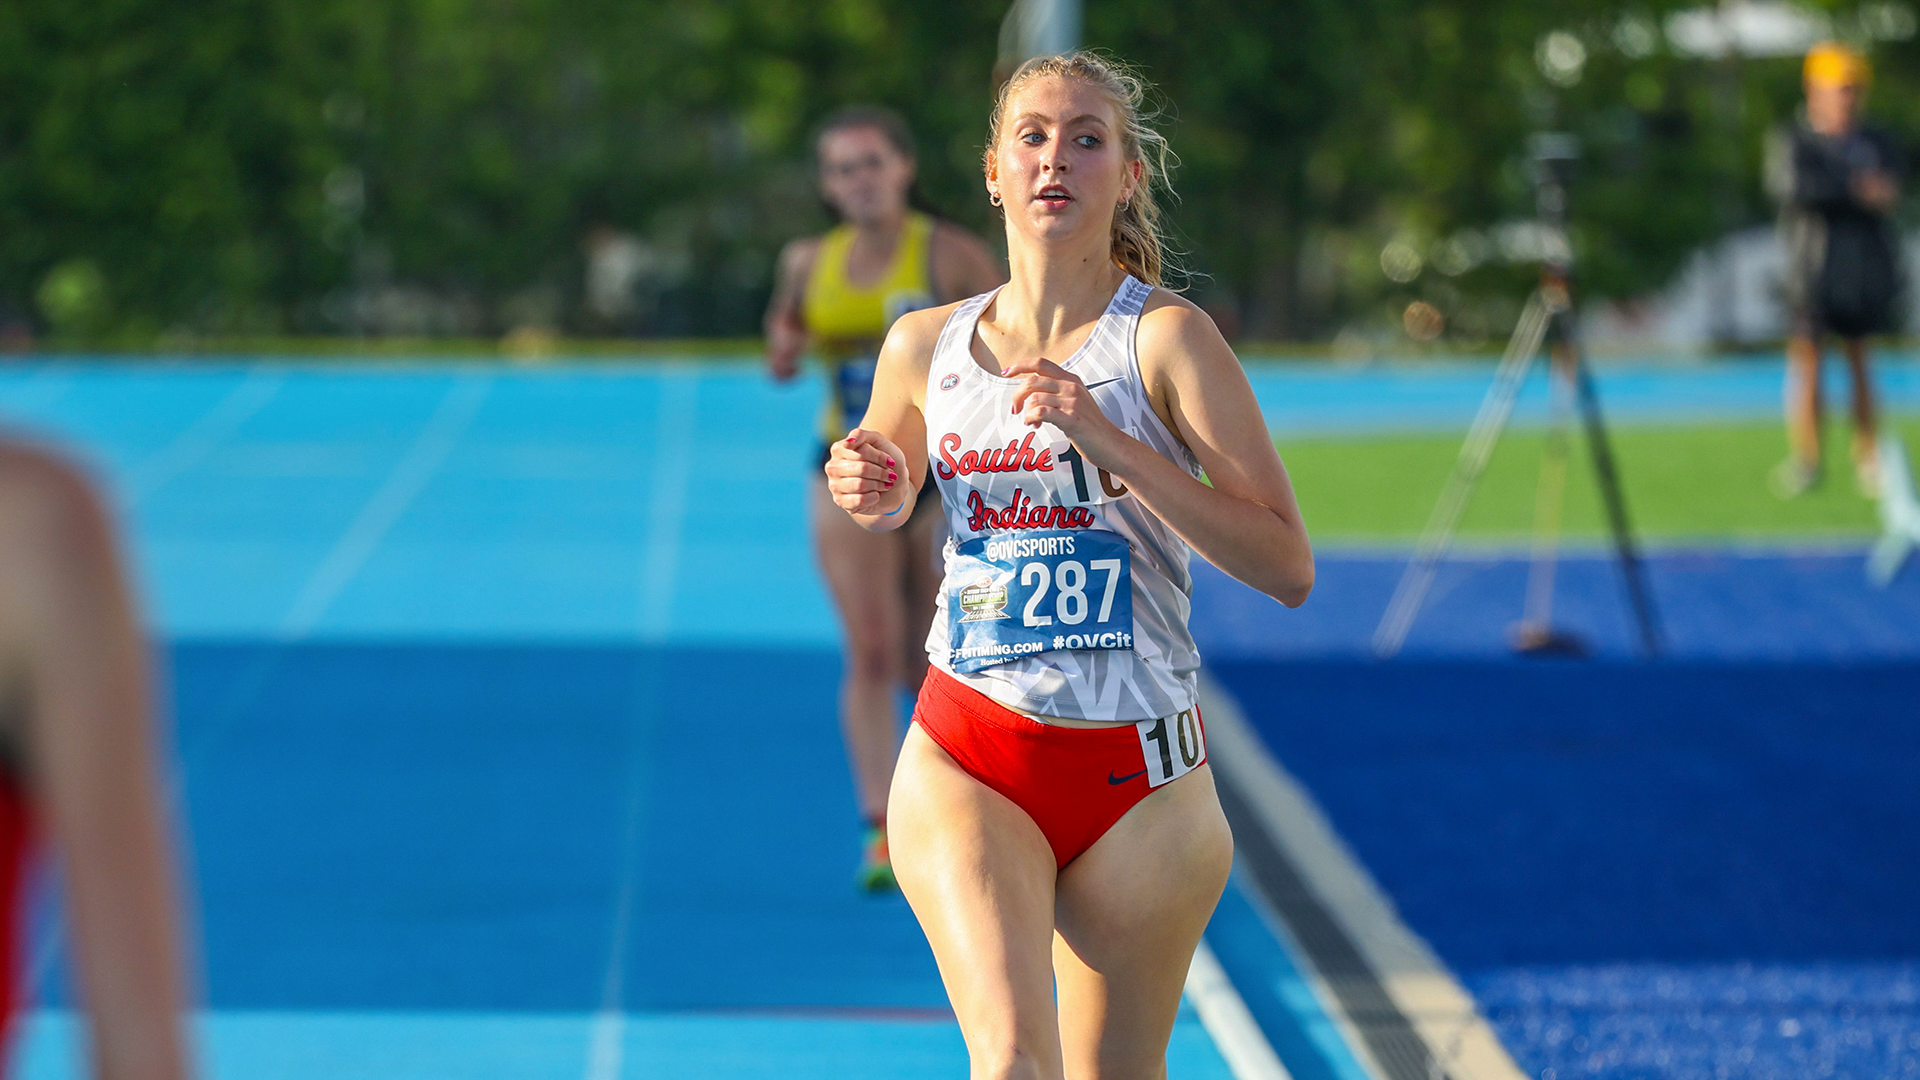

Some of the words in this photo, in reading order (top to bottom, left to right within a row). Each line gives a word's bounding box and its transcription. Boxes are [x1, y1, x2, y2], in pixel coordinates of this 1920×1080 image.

[937, 431, 1053, 480] Southe
[967, 488, 1094, 532] Indiana
[986, 536, 1075, 562] @OVCSPORTS
[1020, 558, 1121, 627] 287
[1052, 631, 1132, 650] #OVCit
[1145, 709, 1199, 779] 10
